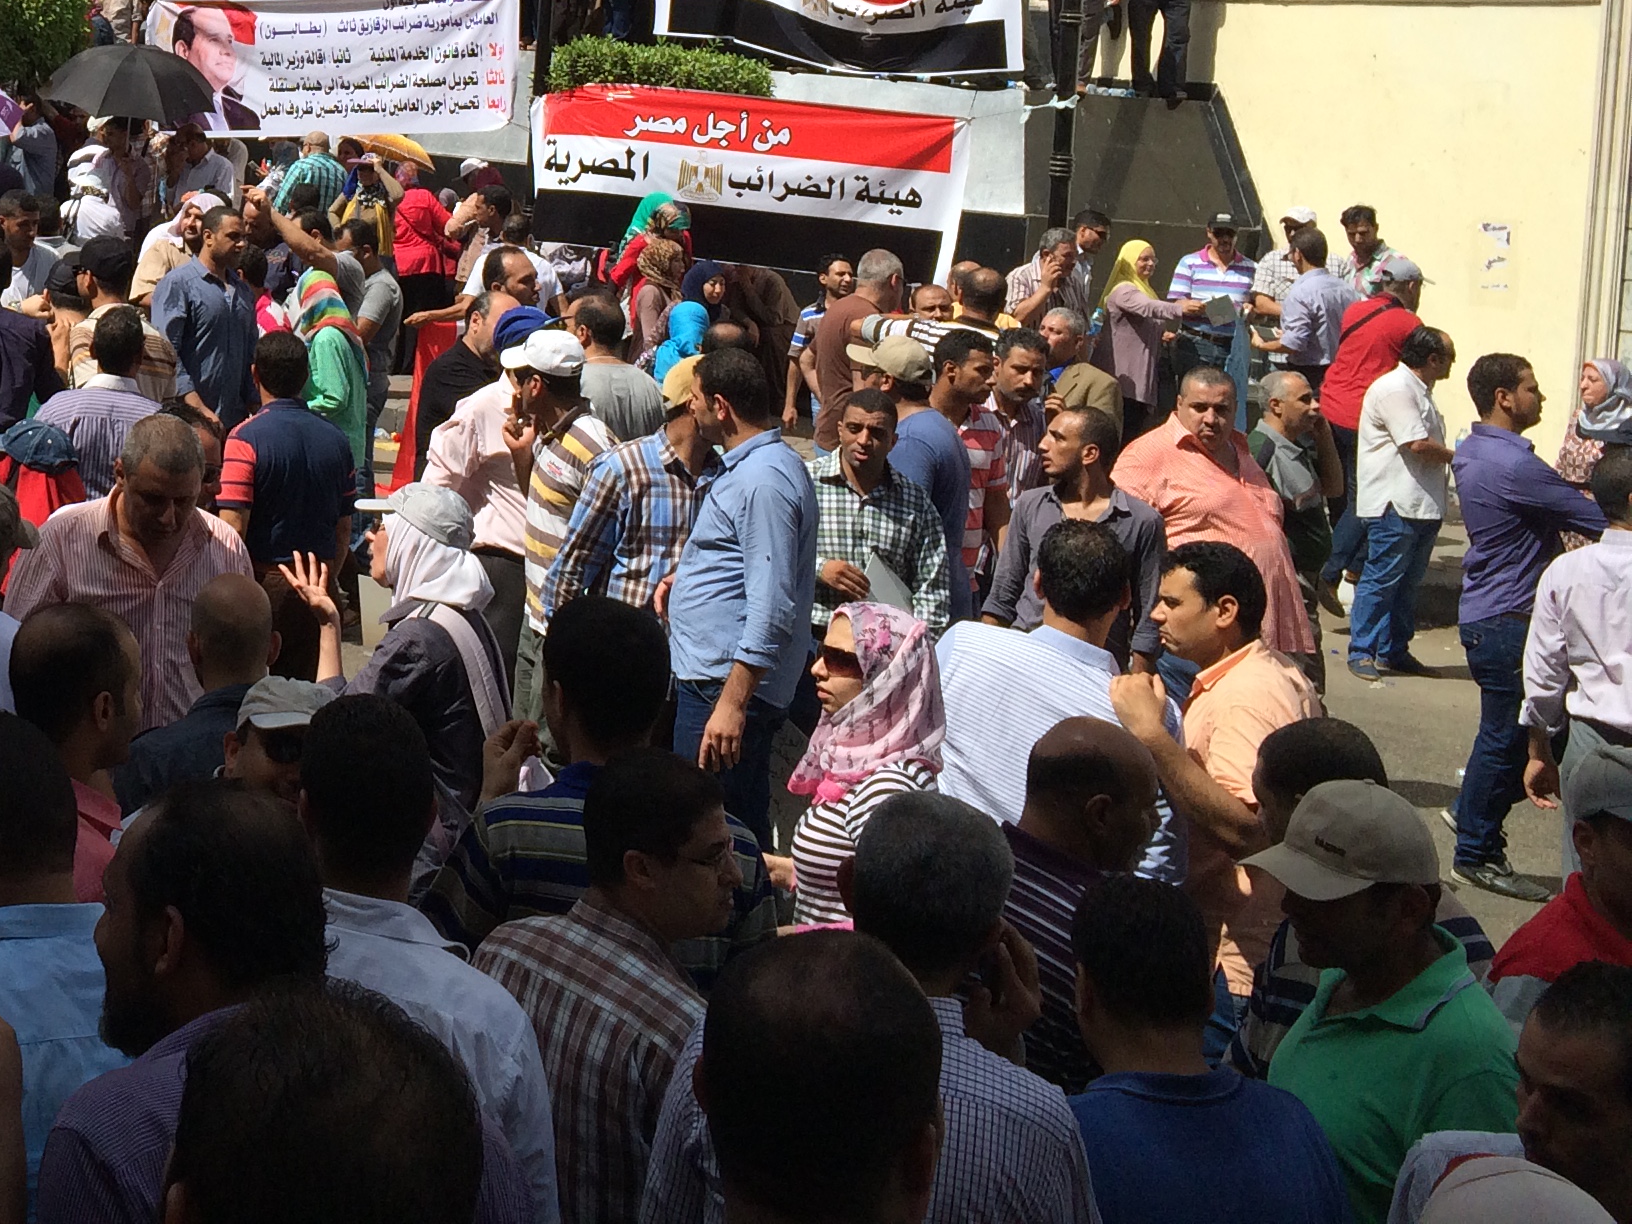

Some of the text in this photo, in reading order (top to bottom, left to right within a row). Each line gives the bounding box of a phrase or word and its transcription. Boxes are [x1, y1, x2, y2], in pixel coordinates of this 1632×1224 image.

[336, 17, 357, 33] ثالث
[357, 15, 392, 36] الزقازيق
[392, 15, 423, 33] ضرائب
[423, 14, 463, 33] بمأمورية
[465, 11, 499, 30] العاملين
[260, 51, 284, 71] المالية
[285, 50, 305, 71] وزير
[369, 46, 400, 67] المدنية
[399, 44, 434, 62] الخدمة
[433, 41, 461, 64] قانون
[269, 77, 301, 93] مستقلة
[301, 76, 323, 96] هيئة
[339, 75, 374, 95] المصرية
[374, 73, 412, 94] الضرائب
[412, 73, 447, 88] مصلحة
[448, 71, 479, 91] تحويل
[260, 101, 285, 120] العمل
[285, 99, 314, 119] ظروف
[315, 99, 349, 118] وتحسين
[349, 98, 387, 117] بالمصلحة
[388, 97, 424, 116] العاملين
[423, 93, 447, 116] أجور
[448, 95, 480, 115] تحسين
[624, 111, 791, 152] من أجل مصر
[543, 138, 923, 216] هيئة الضرائب المصرية
